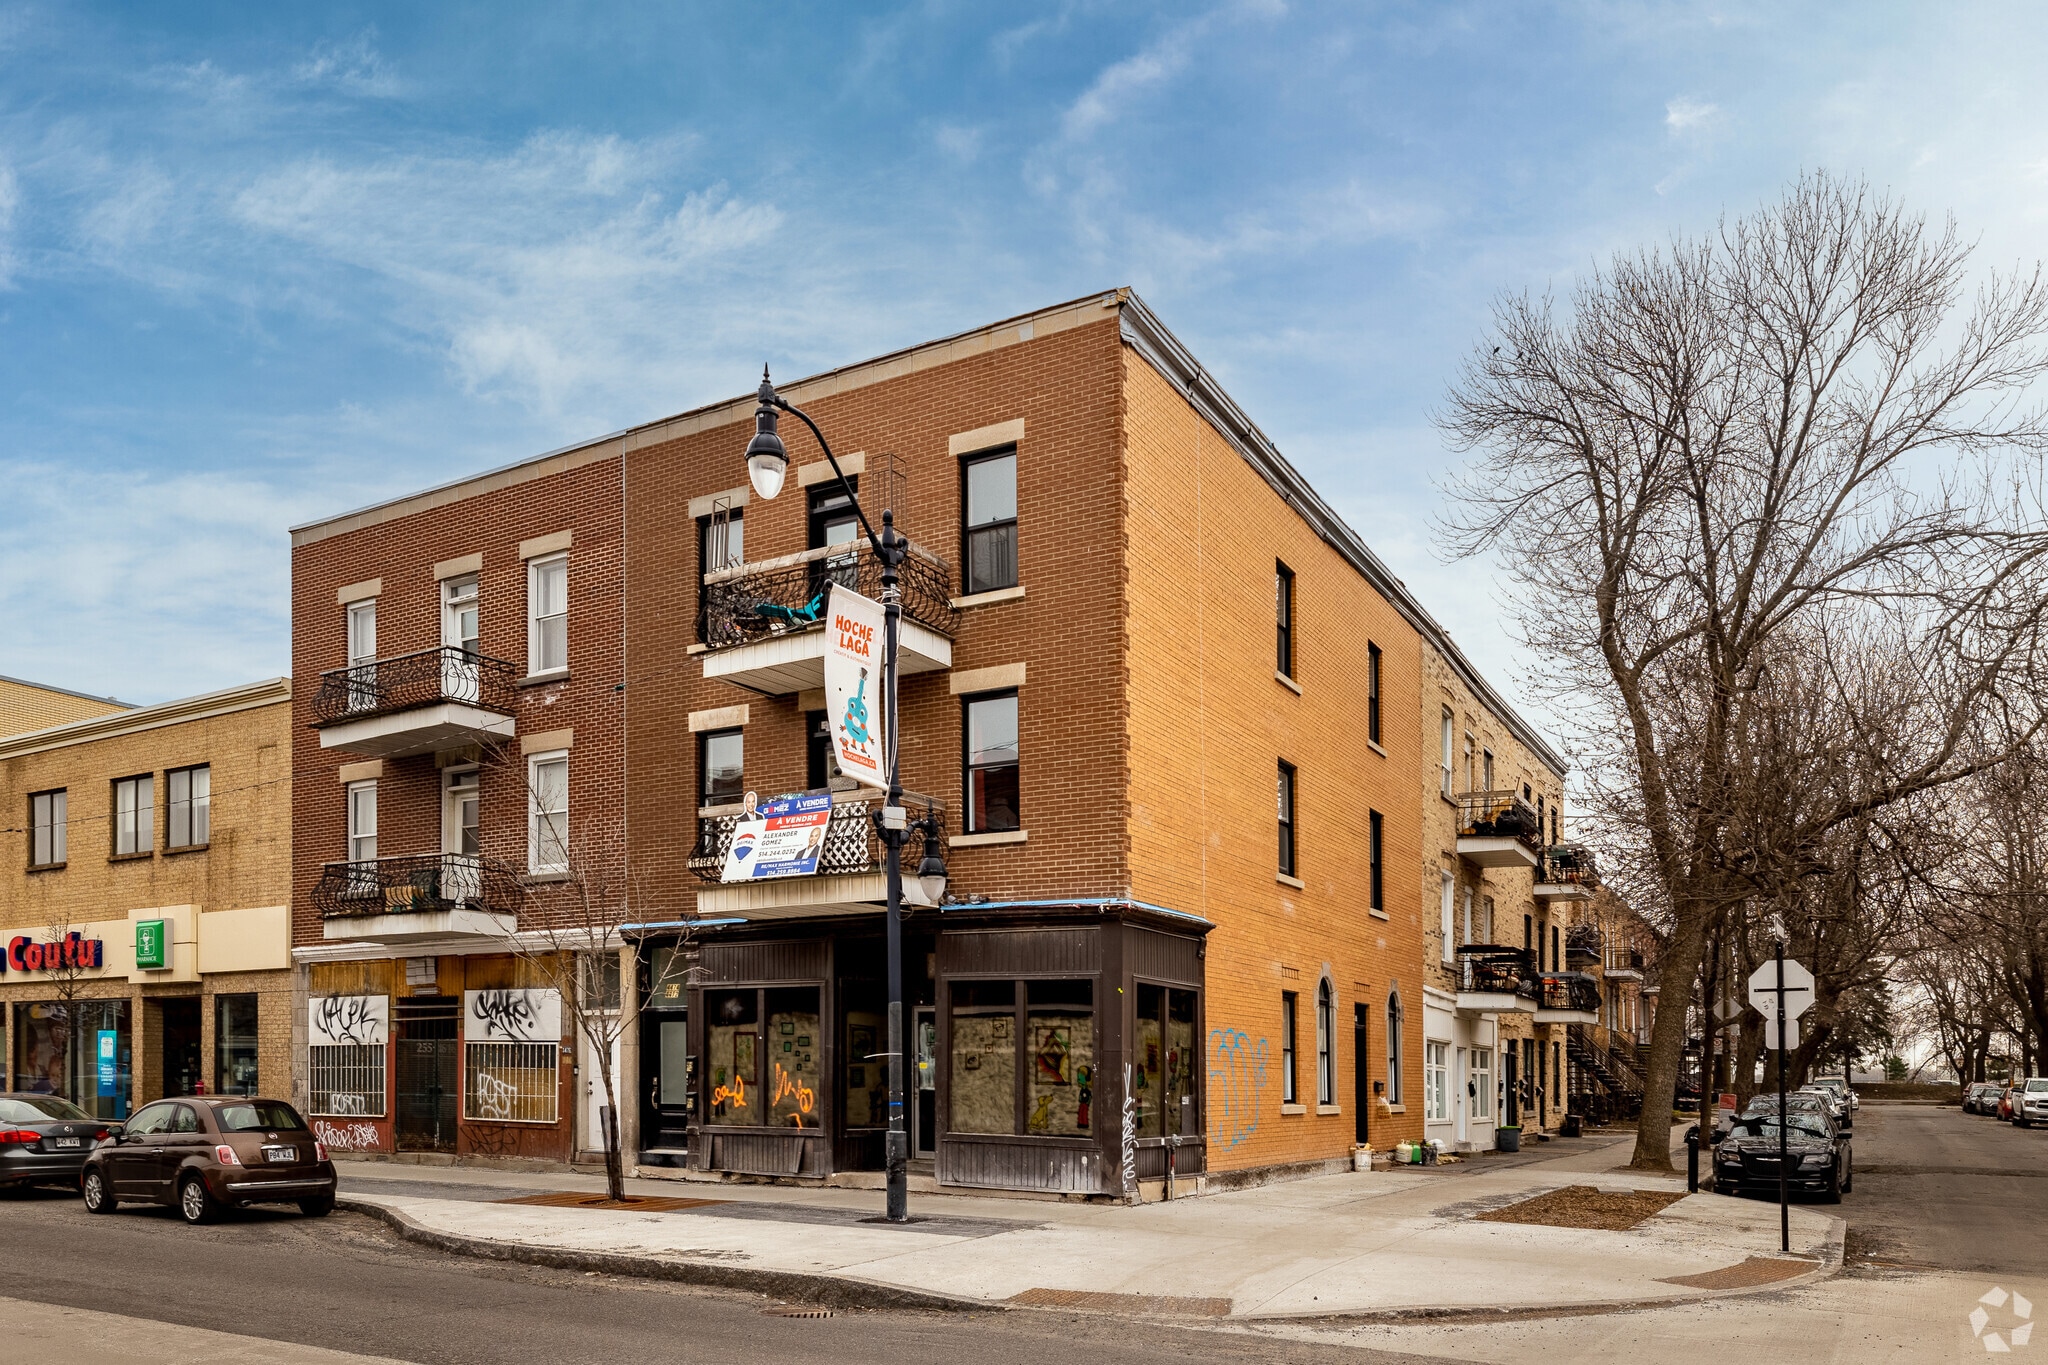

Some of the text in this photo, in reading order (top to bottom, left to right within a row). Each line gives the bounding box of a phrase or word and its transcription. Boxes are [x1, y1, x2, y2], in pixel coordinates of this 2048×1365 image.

[835, 614, 874, 642] HOCHE
[802, 797, 829, 808] VENDRE
[785, 814, 818, 824] VENDRE
[763, 830, 798, 839] ALEXANDER
[8, 931, 102, 971] Coutu
